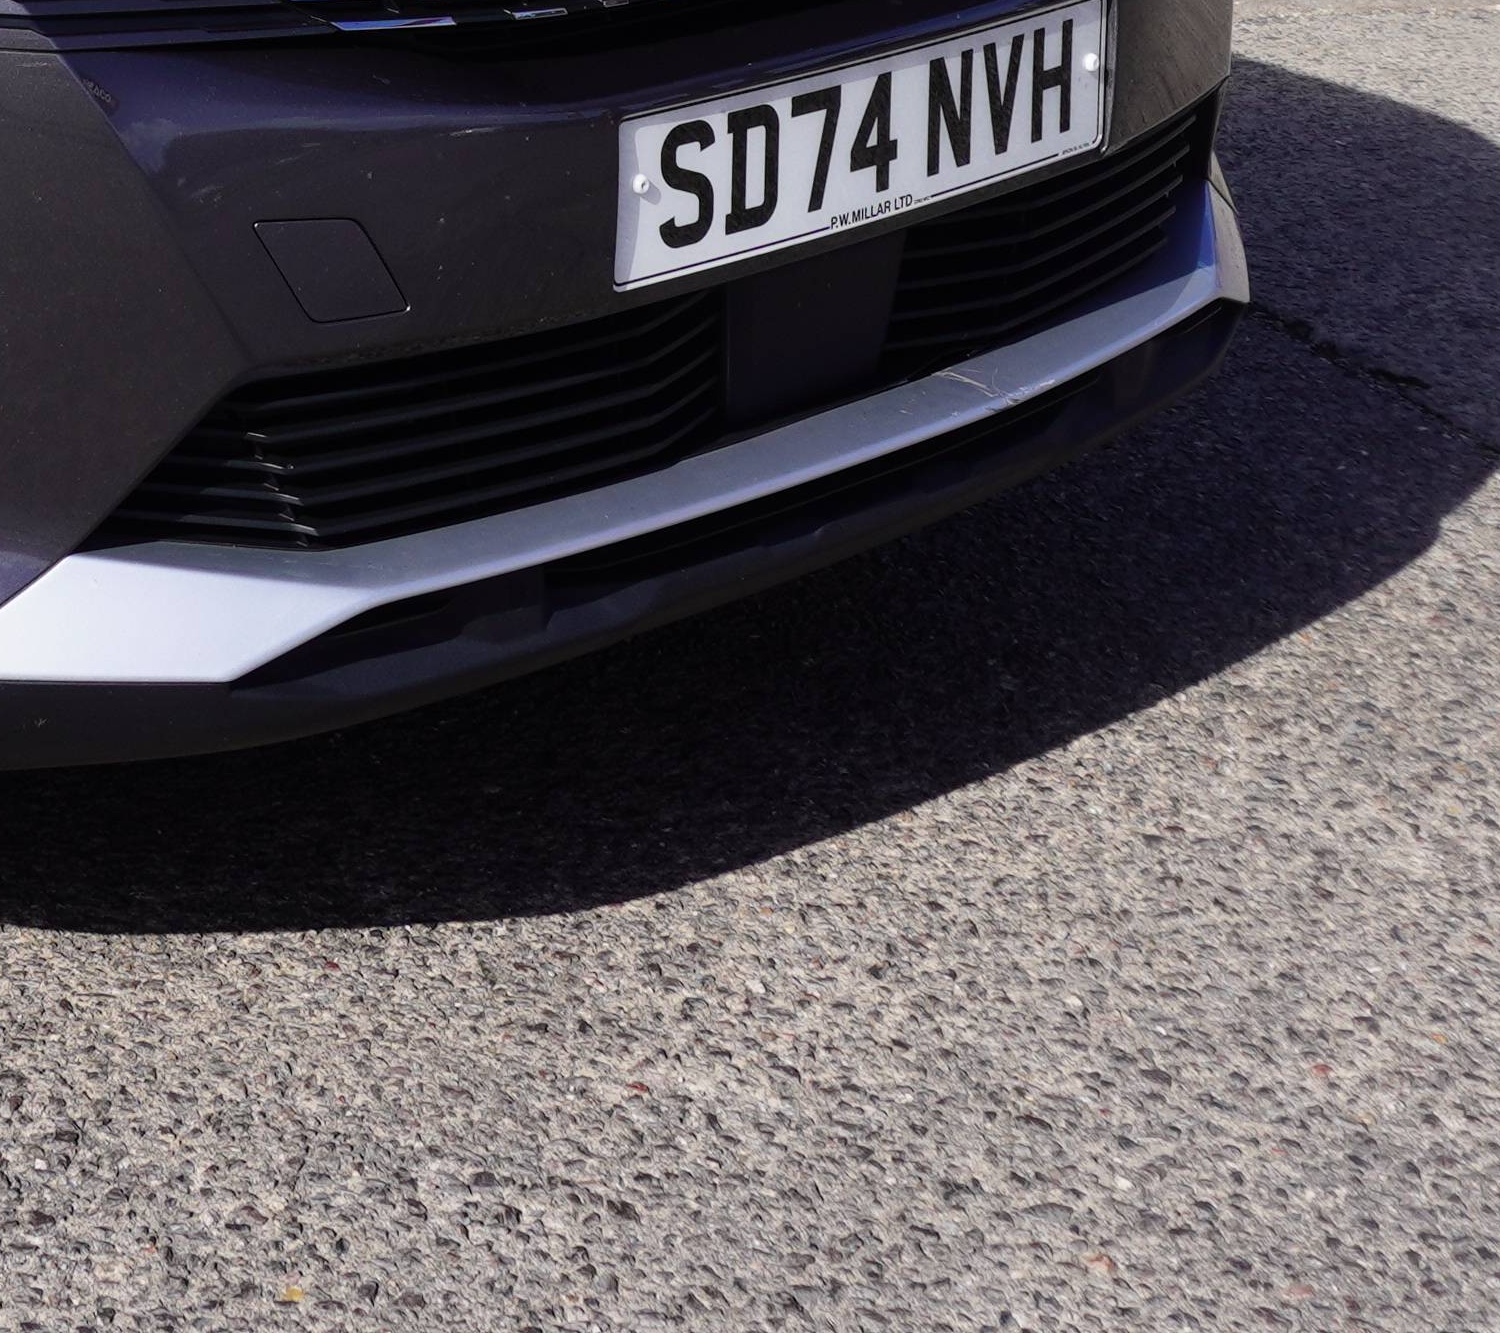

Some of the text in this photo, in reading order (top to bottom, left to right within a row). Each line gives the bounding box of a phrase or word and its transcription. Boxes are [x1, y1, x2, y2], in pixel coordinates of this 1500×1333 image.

[659, 18, 1075, 250] SD74 NVH
[894, 193, 913, 211] LTD
